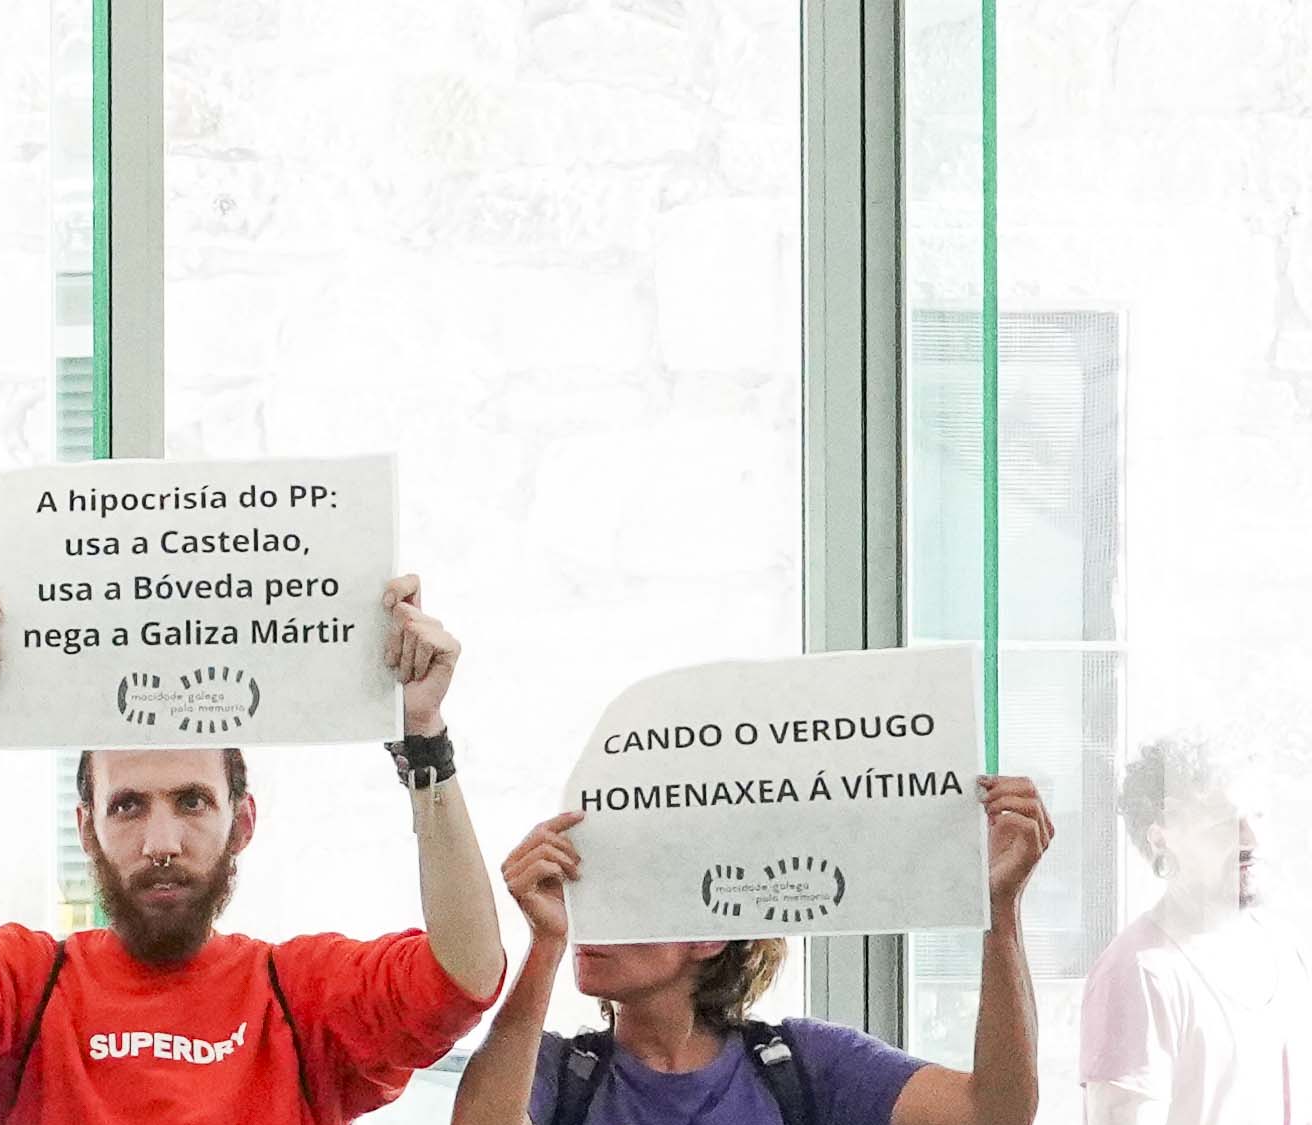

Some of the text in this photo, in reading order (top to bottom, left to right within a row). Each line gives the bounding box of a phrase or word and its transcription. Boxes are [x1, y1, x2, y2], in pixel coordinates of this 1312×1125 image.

[36, 484, 337, 519] A hipocrisía do PP:
[65, 527, 309, 556] usa a Castelao,
[38, 573, 339, 606] usa a Bóveda pero
[24, 617, 355, 655] nega a Galiza Mártir
[604, 713, 935, 755] CANDO O VERDUGO
[581, 767, 963, 812] HOMENAXEA Á VÍTIMA
